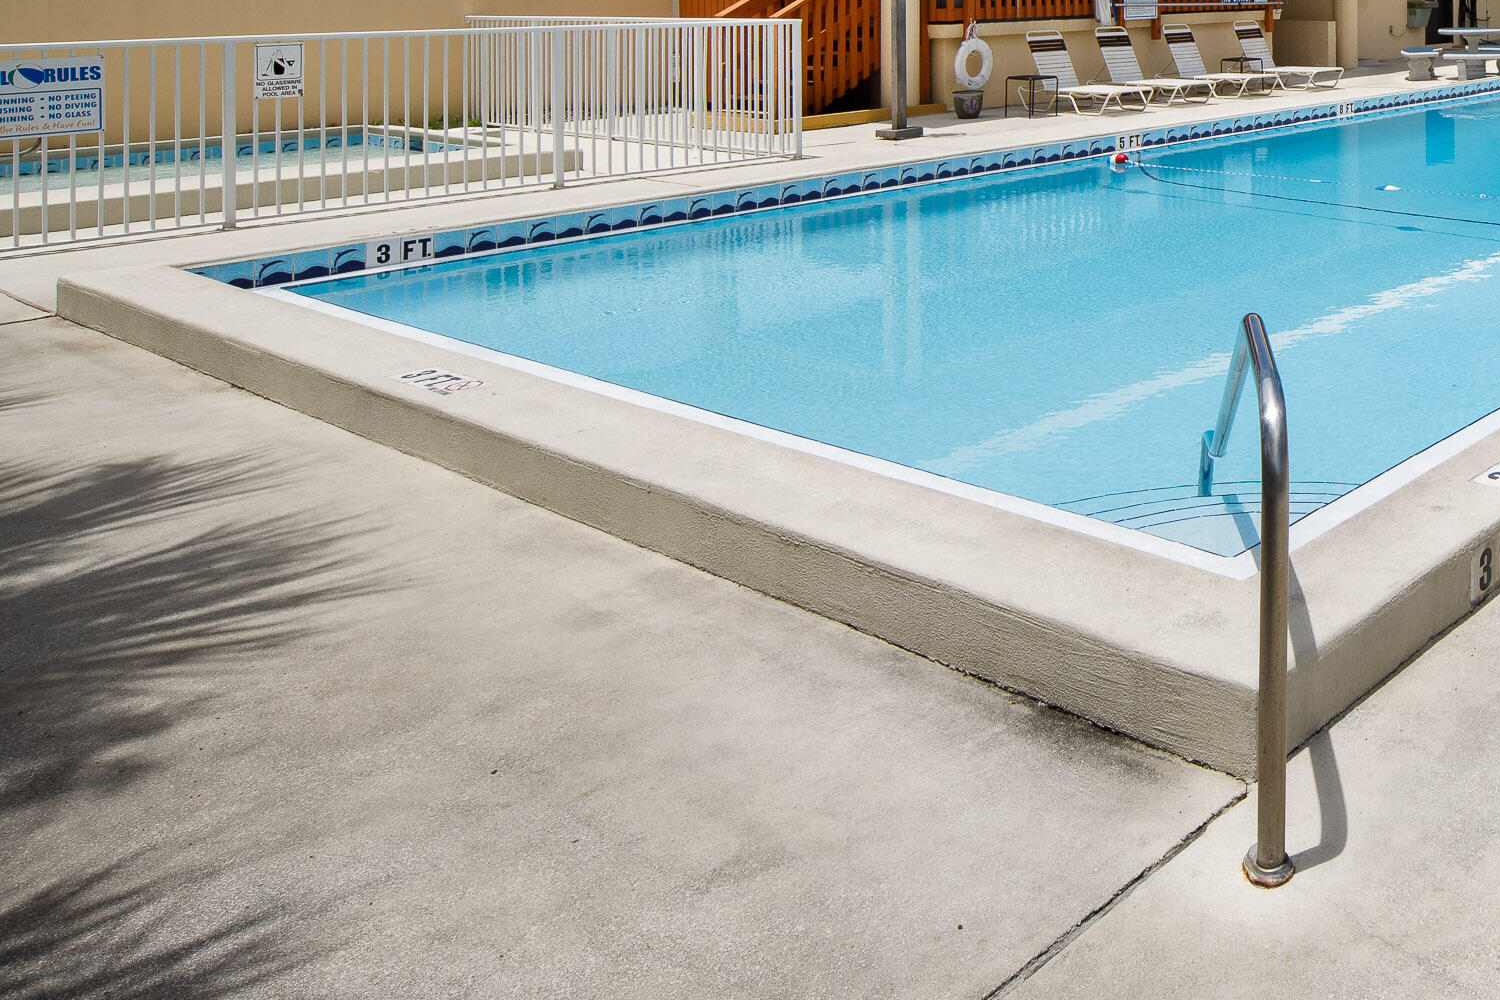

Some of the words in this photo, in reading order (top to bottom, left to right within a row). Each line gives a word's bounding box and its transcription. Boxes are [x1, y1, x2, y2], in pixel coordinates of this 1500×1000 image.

[43, 66, 101, 83] RULES
[64, 93, 97, 101] PEEING
[65, 101, 97, 109] DIVING
[1340, 104, 1344, 115] 8
[65, 110, 91, 118] GLASS
[16, 123, 40, 132] Rules
[53, 121, 74, 129] Have
[1119, 137, 1125, 149] 5
[1129, 134, 1141, 148] FT.
[376, 244, 391, 264] 3
[403, 238, 432, 261] FT.
[1479, 547, 1492, 591] 3
